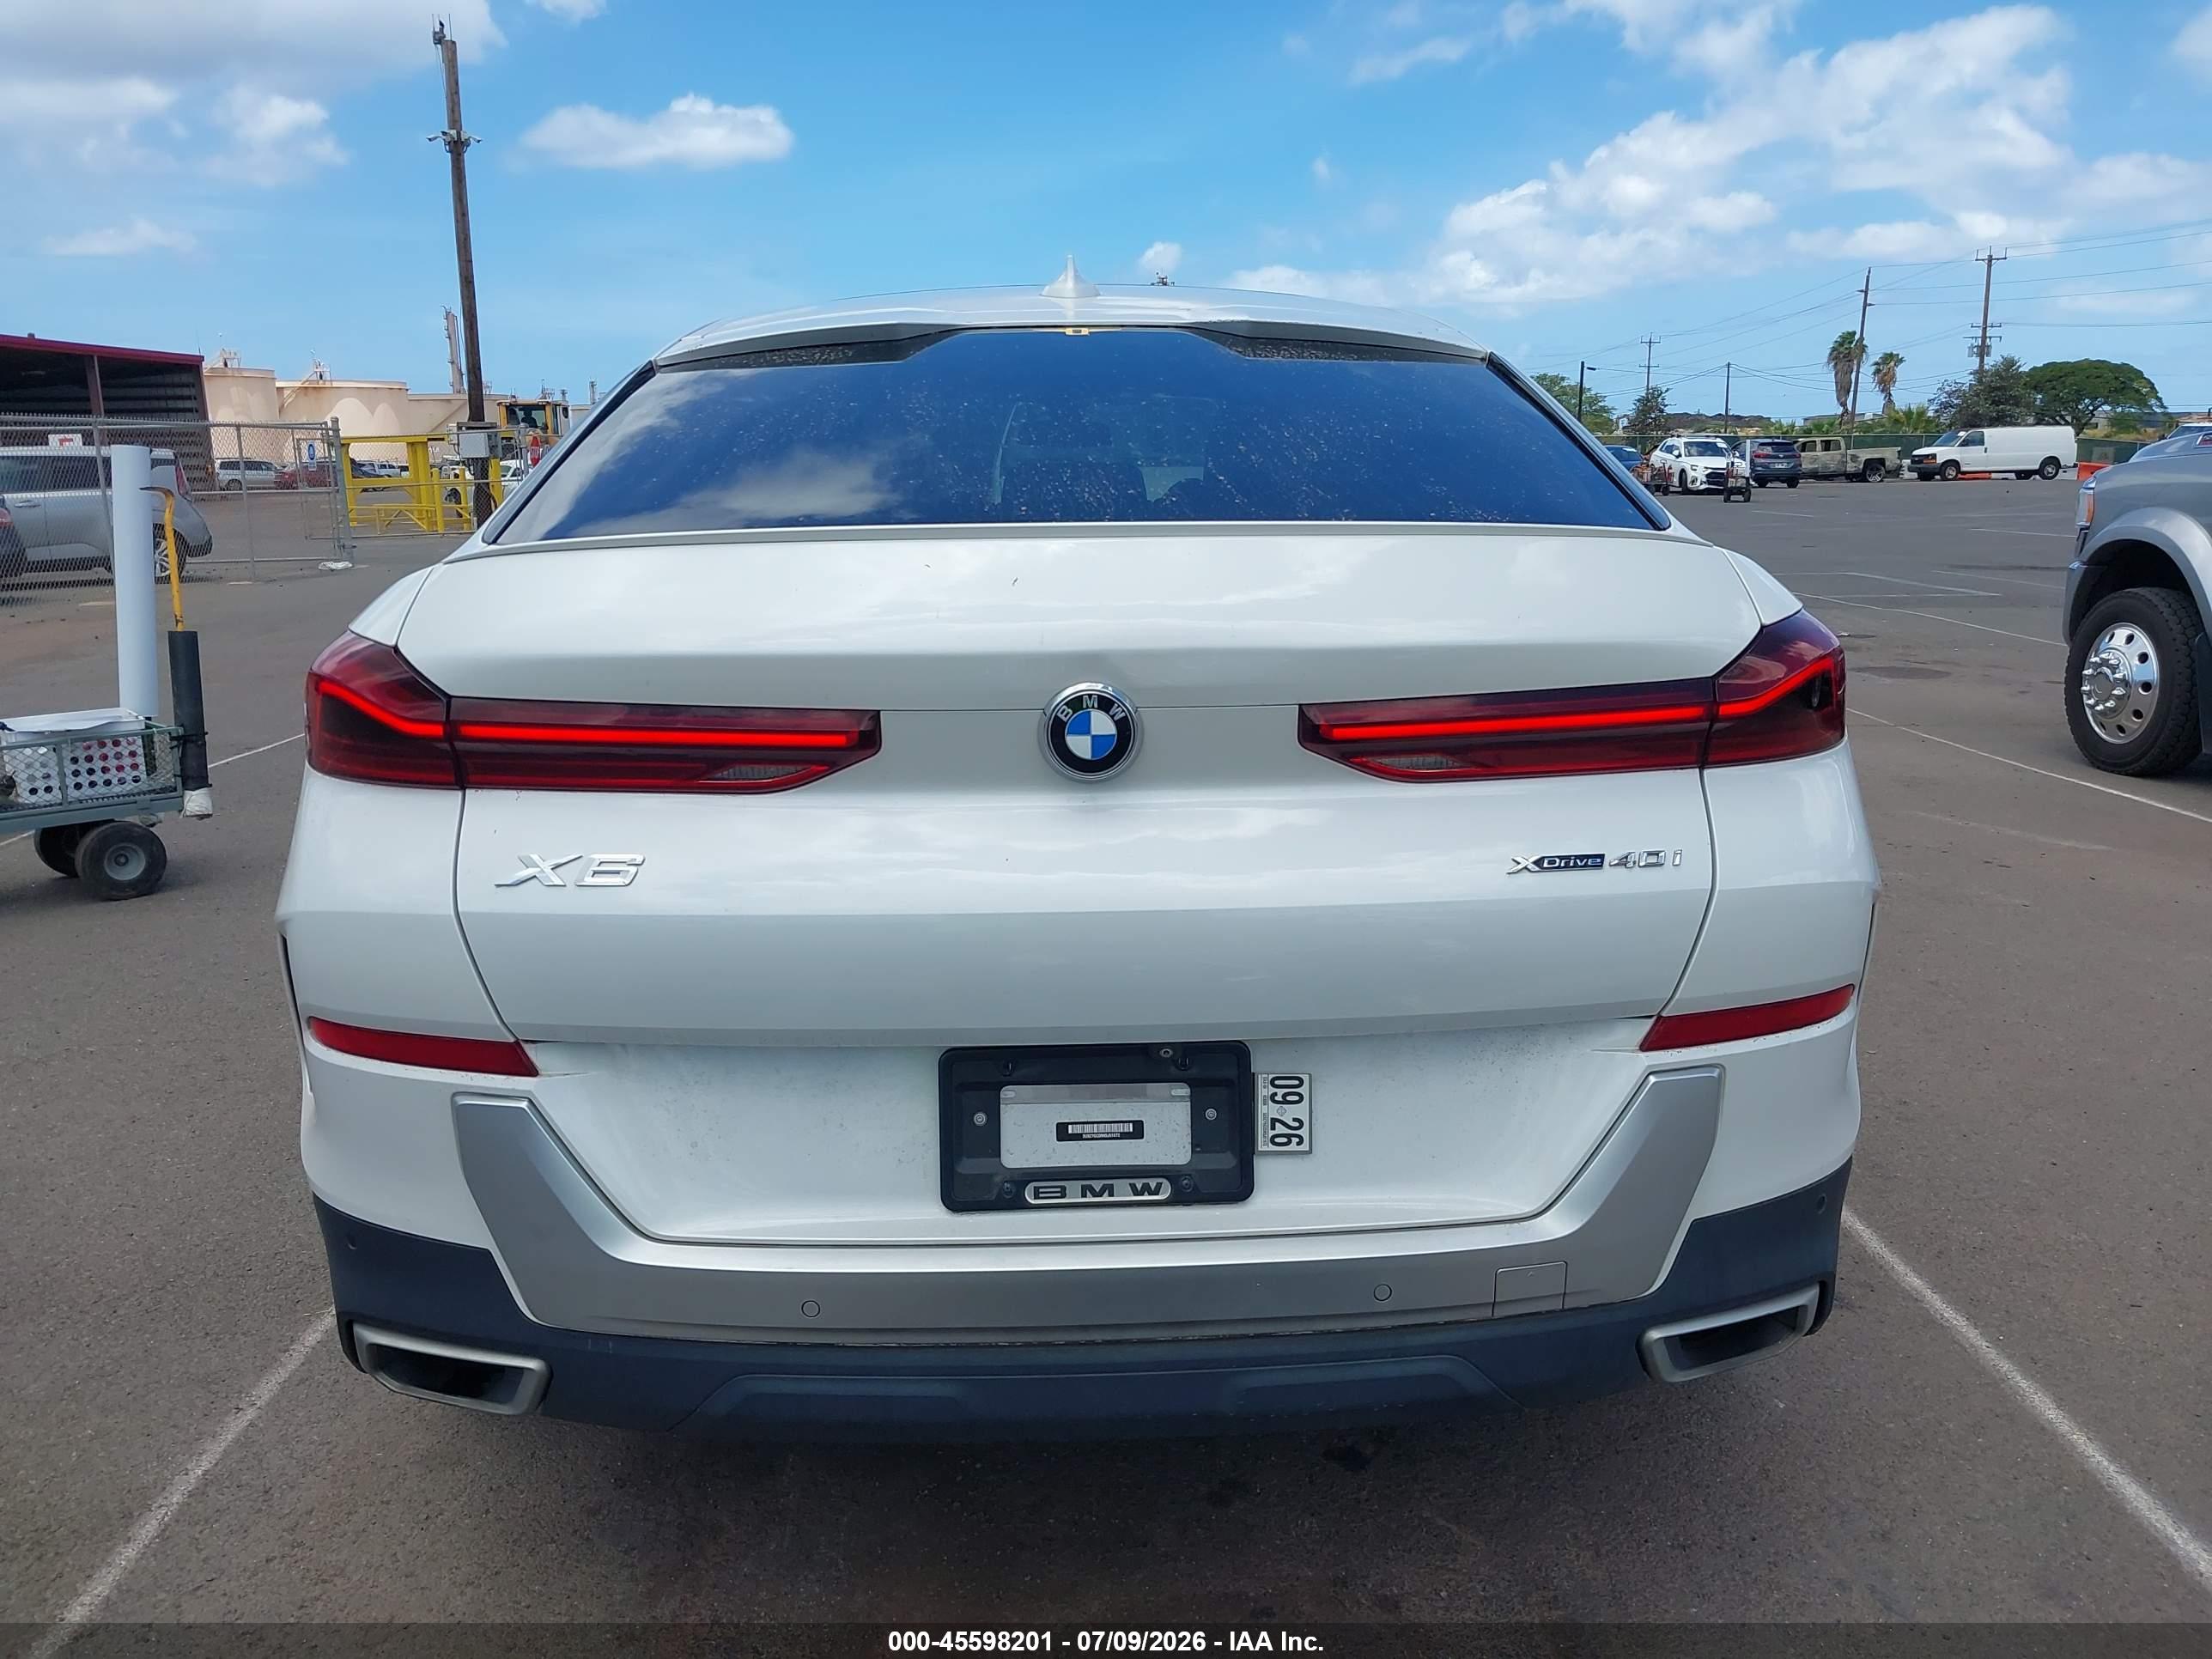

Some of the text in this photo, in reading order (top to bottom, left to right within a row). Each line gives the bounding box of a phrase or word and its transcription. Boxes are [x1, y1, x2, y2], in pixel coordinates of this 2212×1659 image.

[1056, 695, 1126, 722] BMW
[495, 854, 646, 887] X6
[1609, 849, 1682, 868] 40i
[1269, 1075, 1304, 1146] 09 26
[1033, 1182, 1164, 1200] BMW
